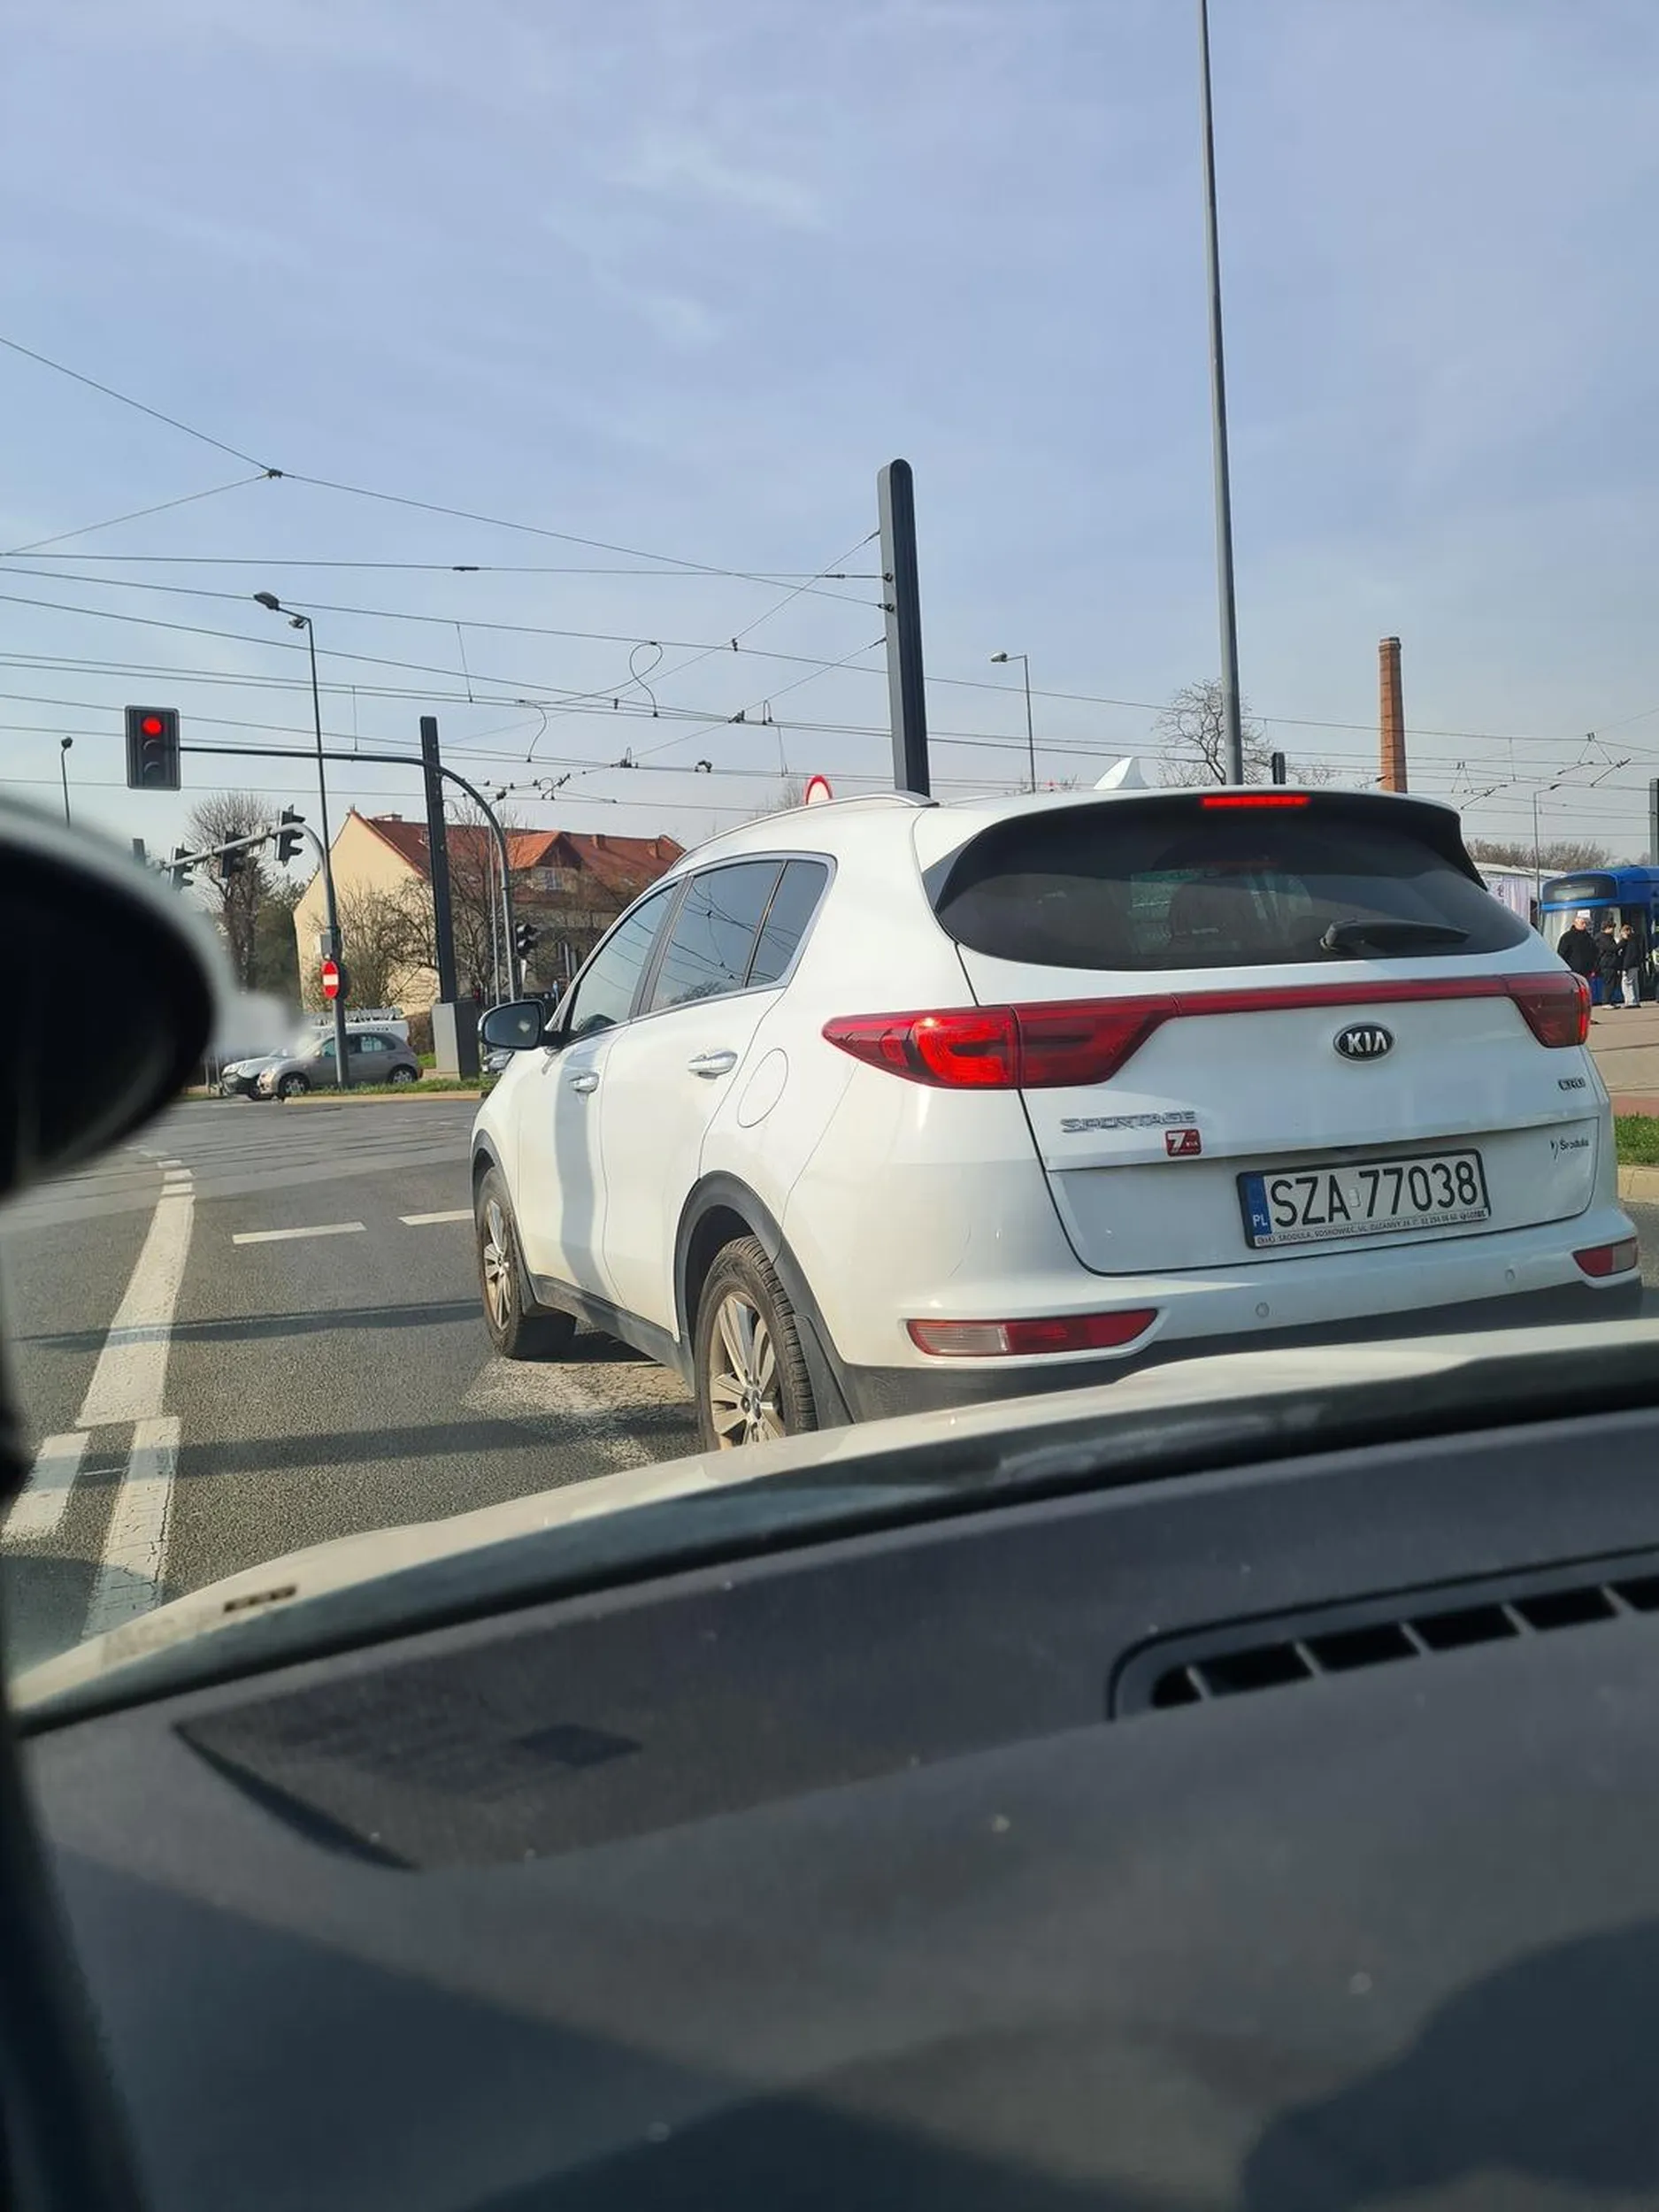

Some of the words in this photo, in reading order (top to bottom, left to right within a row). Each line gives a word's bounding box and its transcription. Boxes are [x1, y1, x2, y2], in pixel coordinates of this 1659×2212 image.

[1347, 1032, 1387, 1053] KIA
[1061, 1110, 1196, 1133] SPORTAGE
[1270, 1174, 1351, 1227] SZA
[1359, 1161, 1479, 1217] 77038
[1253, 1214, 1268, 1226] PL
